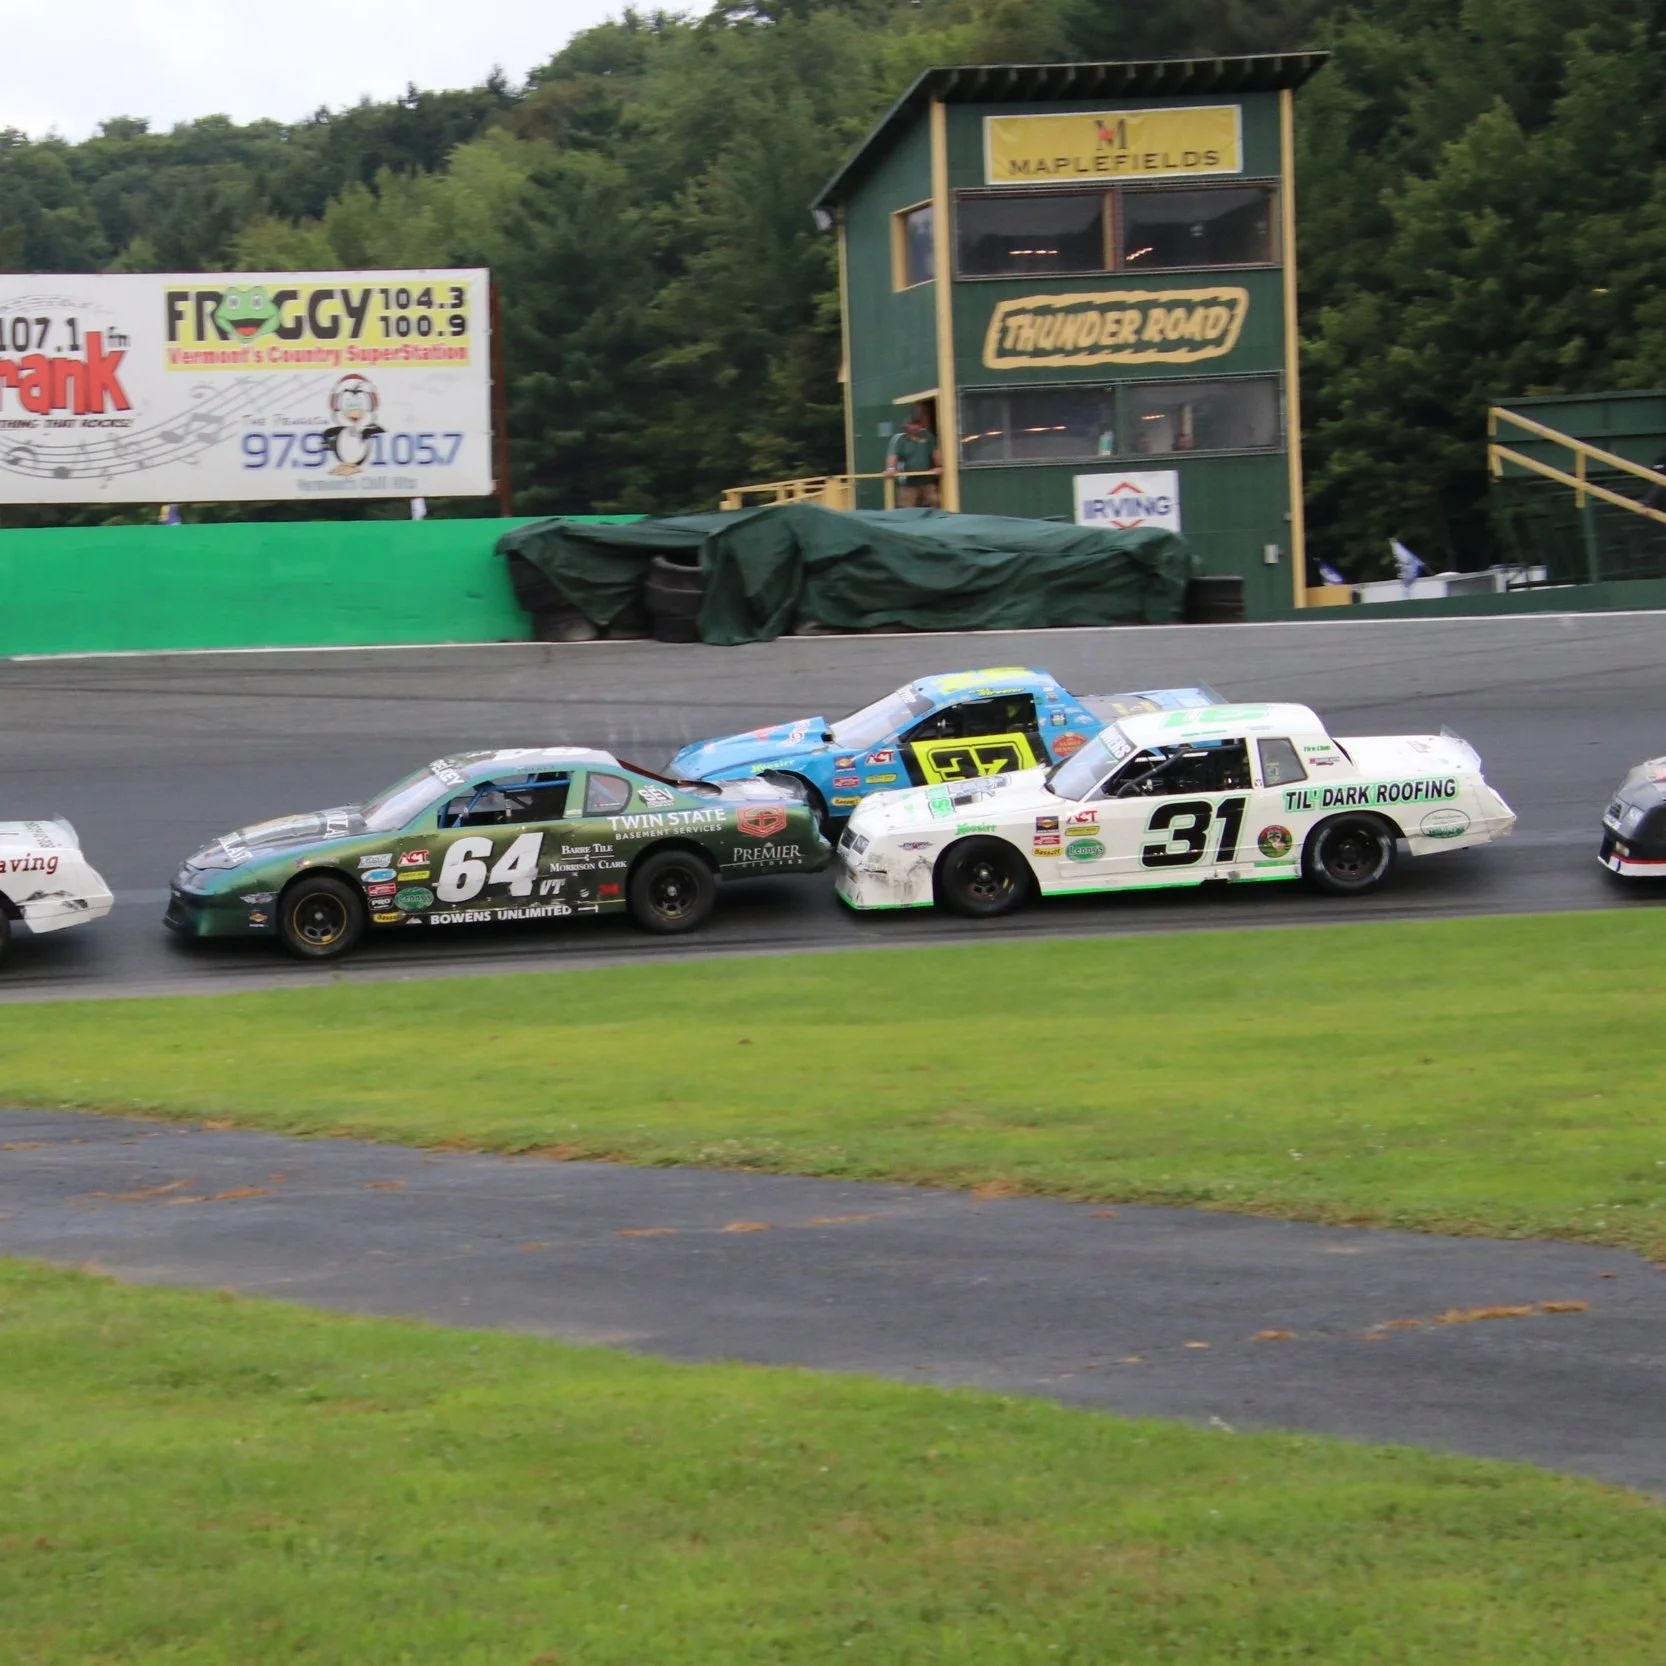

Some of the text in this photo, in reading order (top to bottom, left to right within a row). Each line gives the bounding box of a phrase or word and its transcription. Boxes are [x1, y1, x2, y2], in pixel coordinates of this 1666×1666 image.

[1009, 150, 1221, 176] MAPLEFIELDS
[380, 285, 465, 310] 104.3
[380, 313, 467, 338] 100.9
[1003, 305, 1232, 352] THUNDER ROAD
[169, 342, 469, 367] Vermont's Country SuperStation
[241, 432, 464, 469] 97.9 105.7
[1083, 496, 1171, 520] IRVING
[865, 750, 895, 766] ACT
[1286, 778, 1456, 811] TIL' DARK ROOFING
[606, 808, 727, 832] TWIN STATE
[1066, 810, 1098, 824] ACT
[615, 823, 722, 841] BASEMENT SERVICES
[1142, 797, 1246, 868] 31
[398, 850, 430, 866] ACT
[561, 843, 614, 855] BARRE TILE
[733, 843, 802, 862] PREMIER
[436, 832, 545, 903] 64
[549, 859, 627, 873] MORRISON CLARK
[539, 878, 566, 896] VT
[371, 898, 391, 906] PRO
[430, 905, 572, 926] BOWENS UNLIMITED
